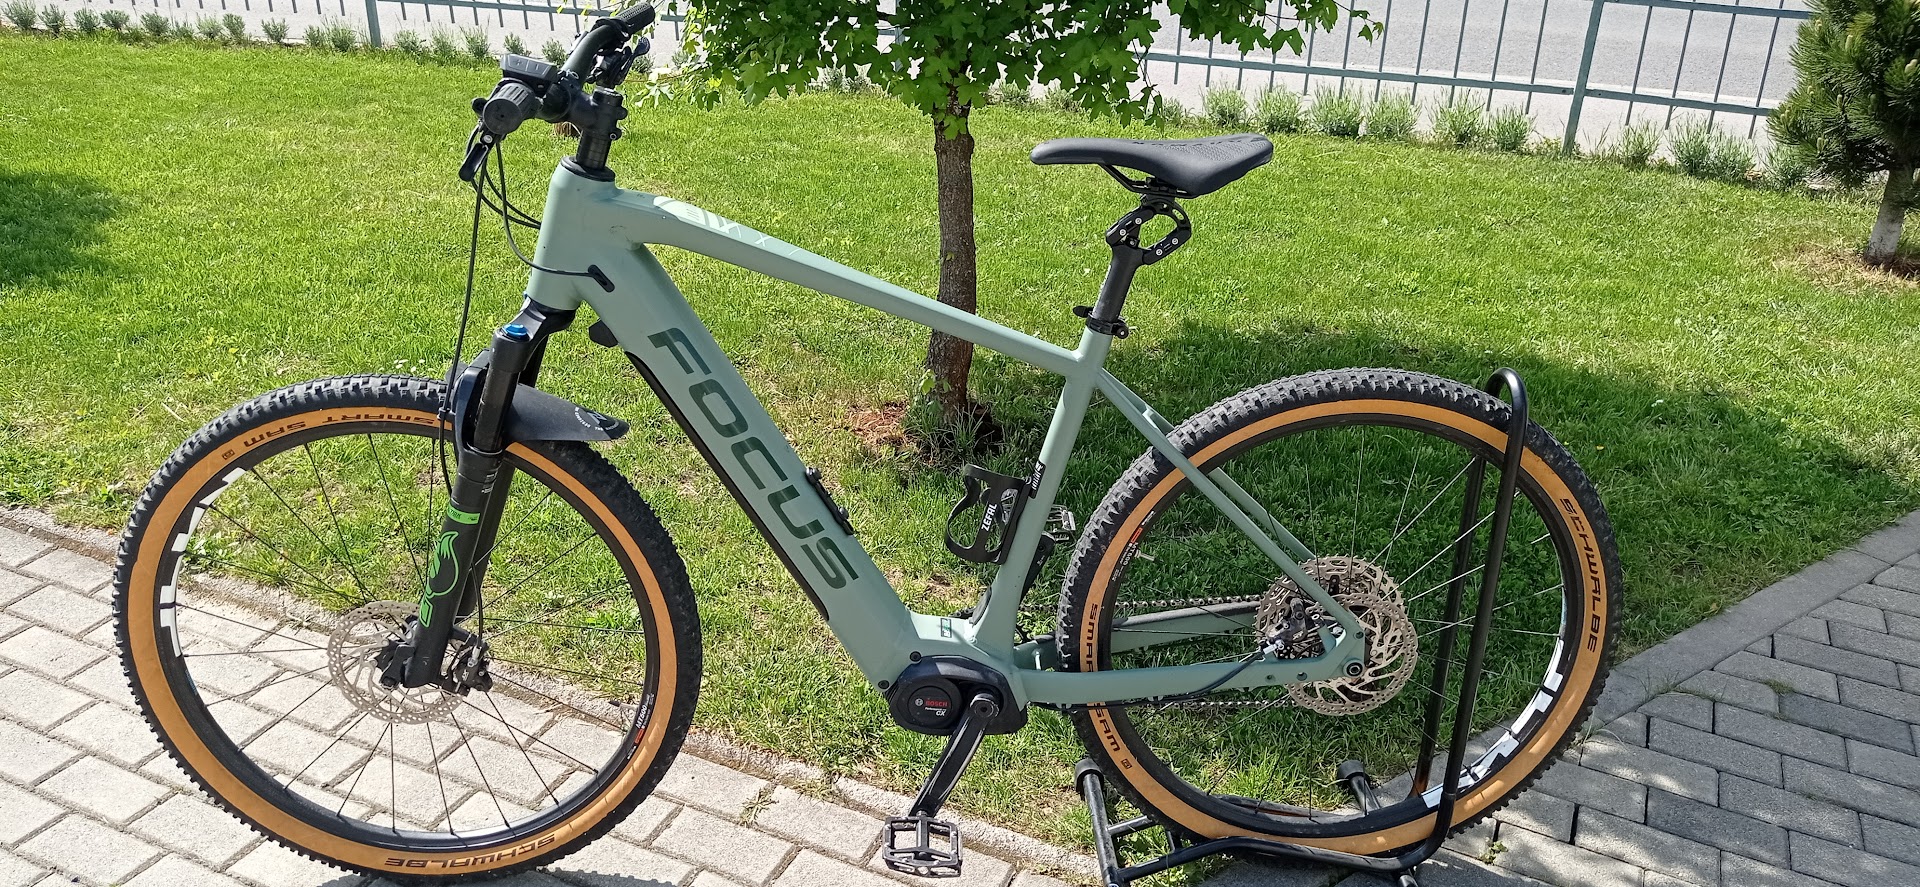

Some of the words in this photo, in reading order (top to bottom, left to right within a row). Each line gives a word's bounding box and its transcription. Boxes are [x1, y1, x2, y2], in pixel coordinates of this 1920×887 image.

[243, 421, 307, 448] SAM
[322, 413, 435, 424] SMART
[648, 327, 859, 589] FOCUS
[981, 503, 998, 531] ZEFAL
[1560, 498, 1601, 653] SCHWALBE
[1086, 603, 1099, 672] SMAR
[384, 833, 555, 868] SCHWALBE
